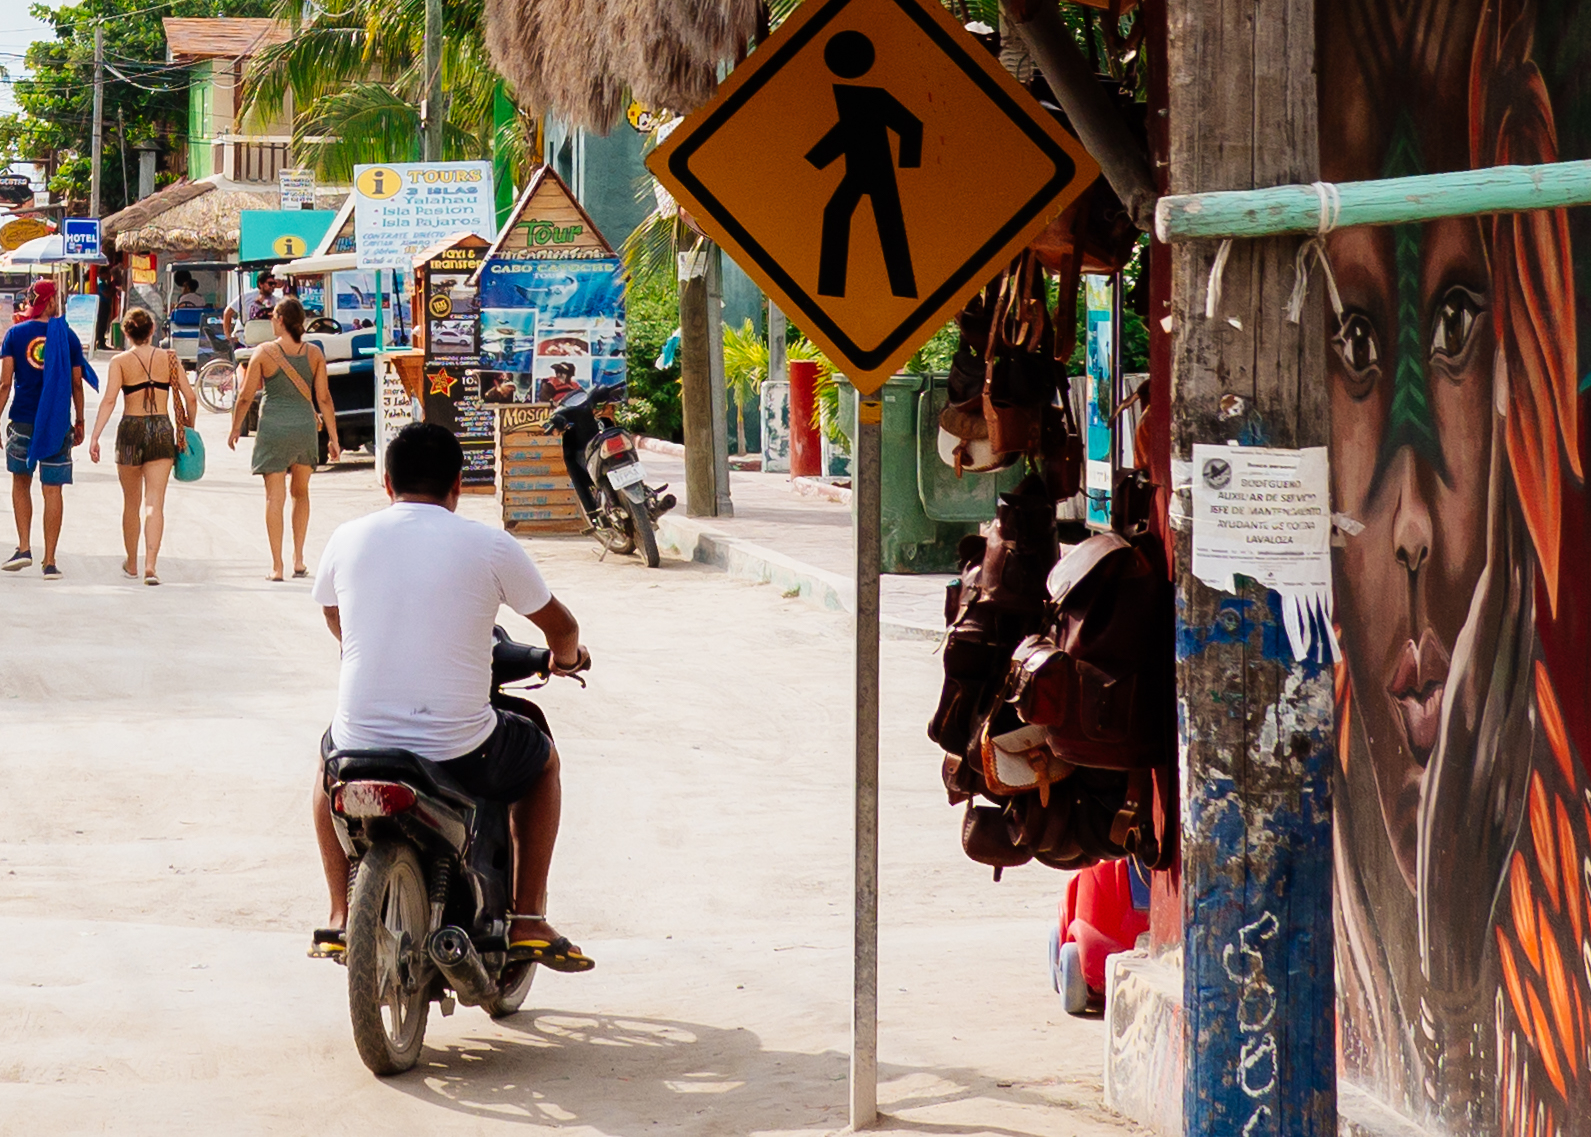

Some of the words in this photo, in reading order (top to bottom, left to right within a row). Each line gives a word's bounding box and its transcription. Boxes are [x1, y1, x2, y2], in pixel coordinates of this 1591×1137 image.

[407, 169, 482, 184] TOURS
[427, 186, 478, 195] ISLAS
[403, 196, 477, 204] Yalahau
[382, 206, 410, 216] Isla
[382, 218, 410, 227] Isla
[515, 219, 583, 247] Tour
[66, 233, 98, 243] HOTEL
[490, 265, 533, 274] CABO
[1265, 493, 1278, 502] DE
[1231, 506, 1245, 514] DE
[1245, 534, 1295, 545] LAVALOZA
